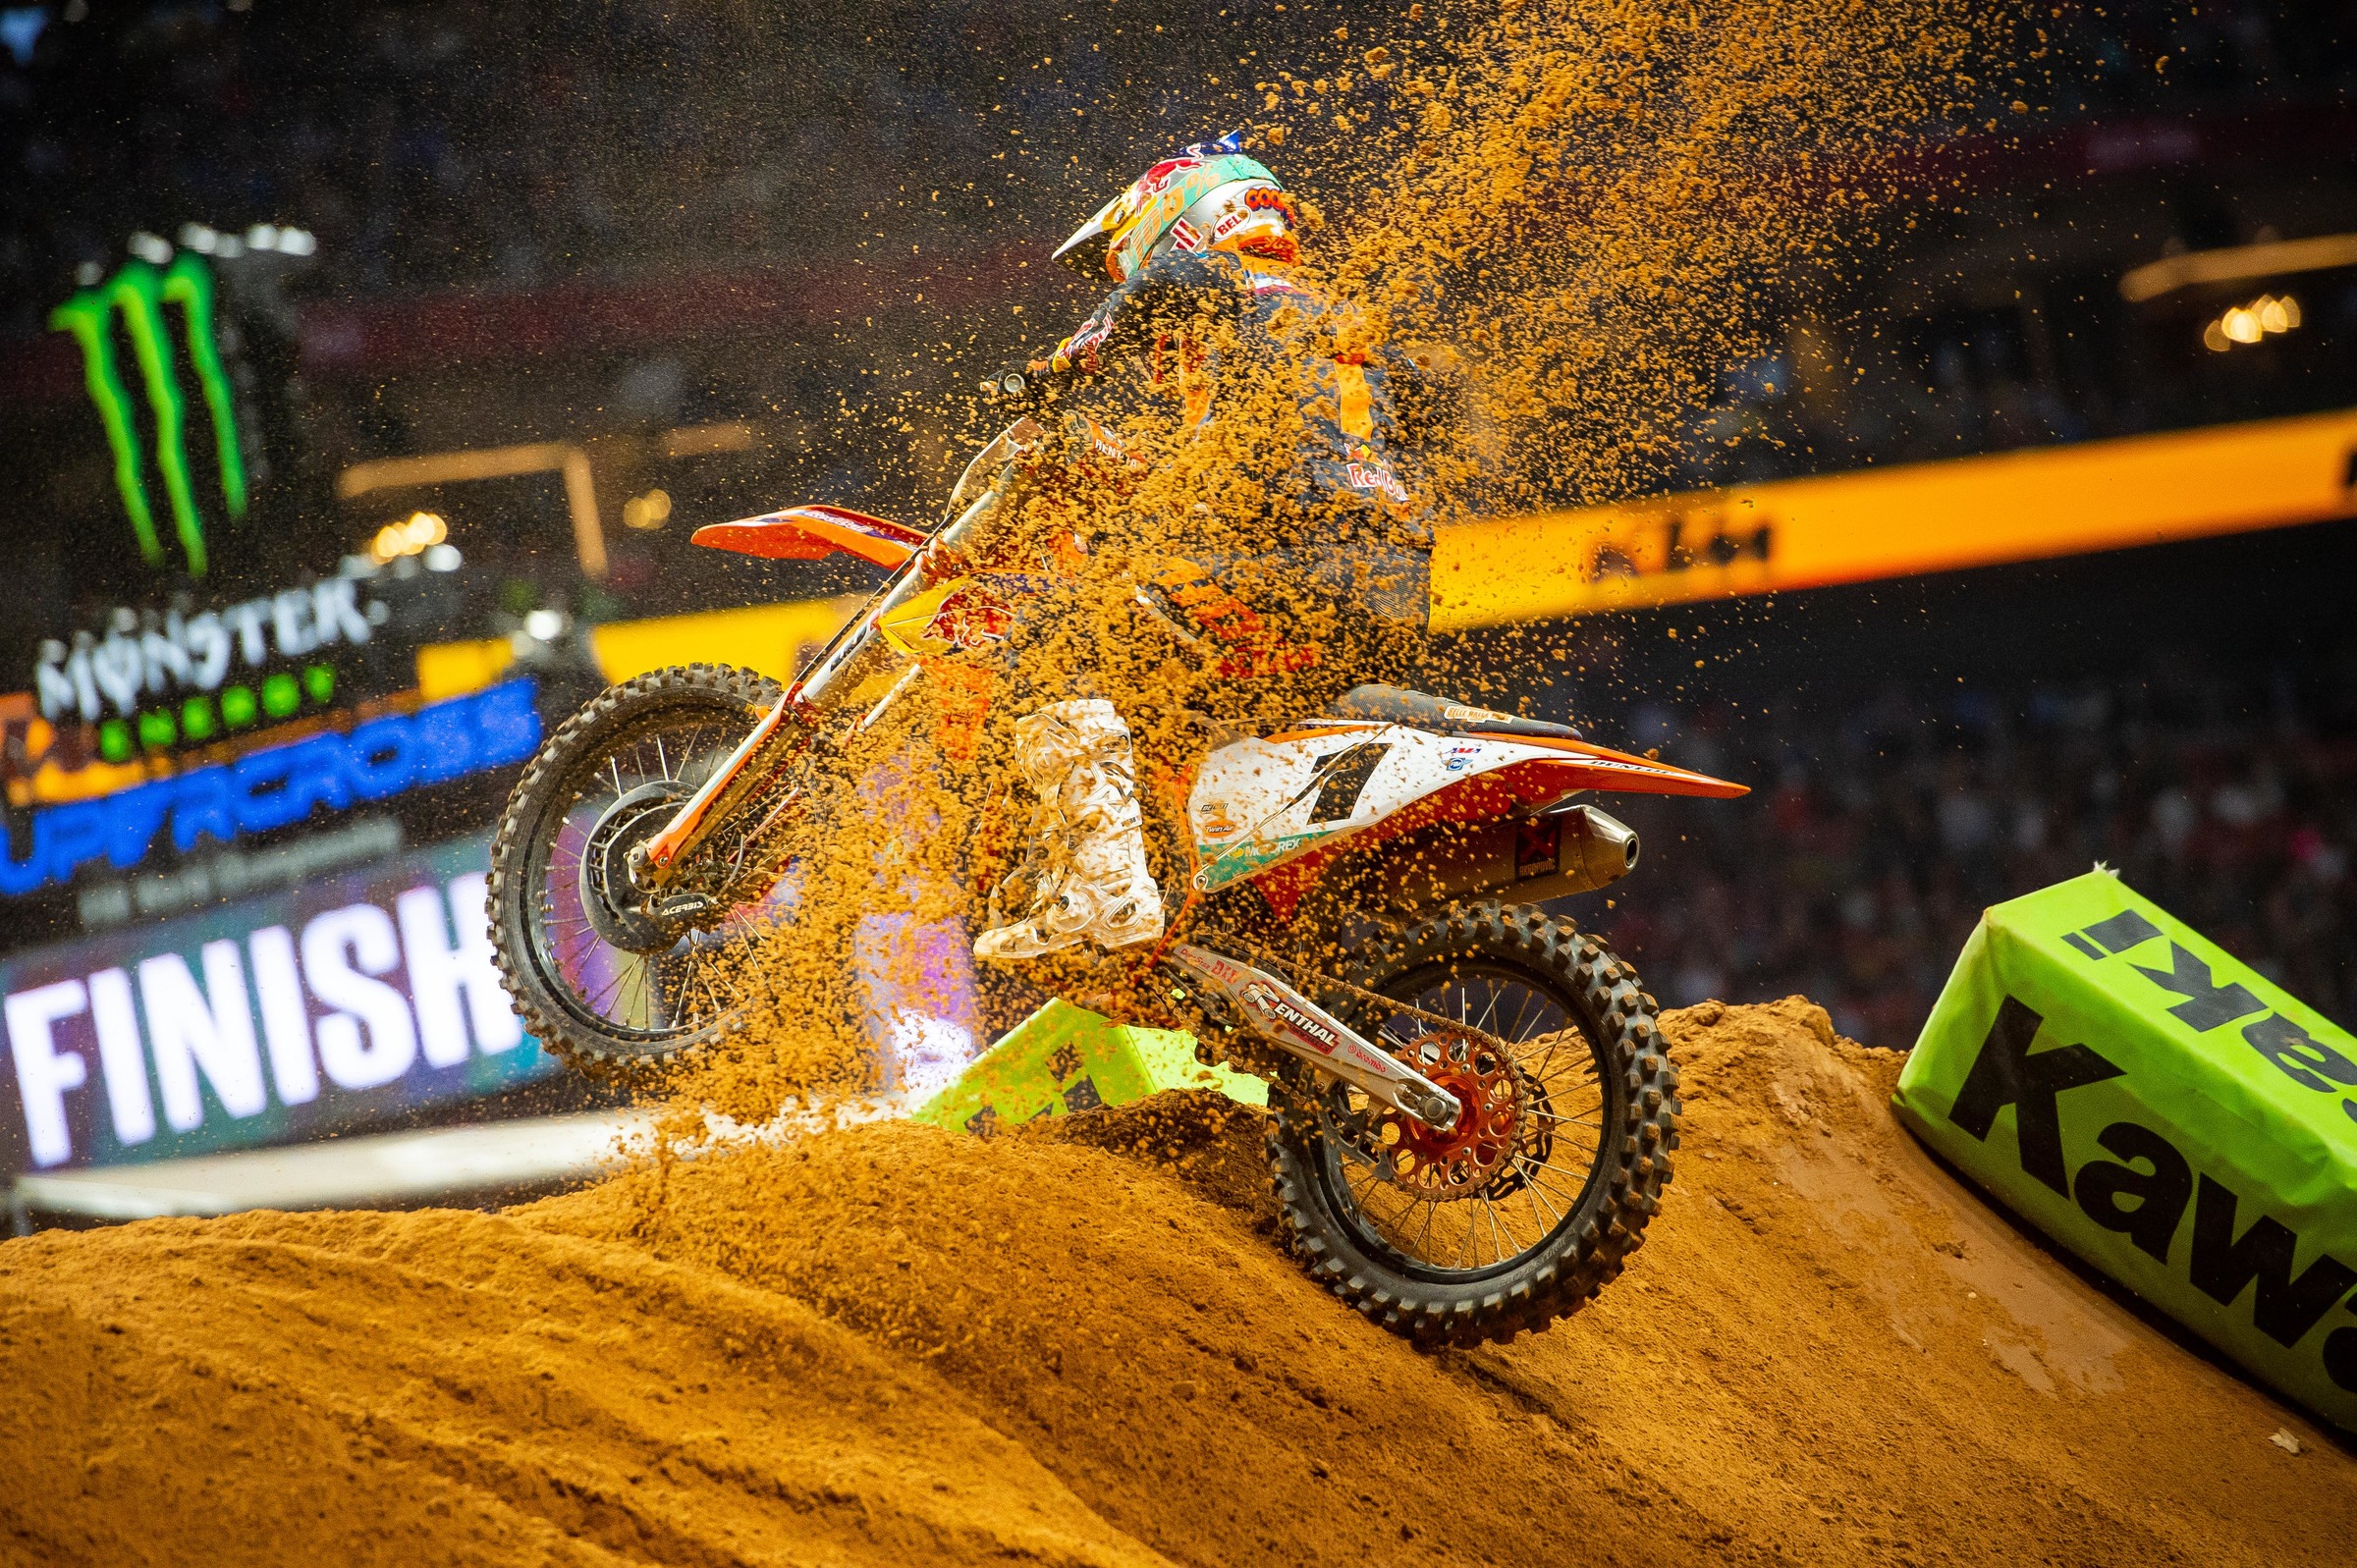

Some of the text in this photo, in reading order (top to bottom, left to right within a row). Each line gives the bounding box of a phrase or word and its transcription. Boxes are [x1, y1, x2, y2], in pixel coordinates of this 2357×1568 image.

[1129, 164, 1221, 262] 100%
[1217, 209, 1248, 236] BEL
[661, 900, 704, 916] ACERBIS
[4, 871, 523, 1168] FINISH
[2060, 909, 2357, 1125] aki
